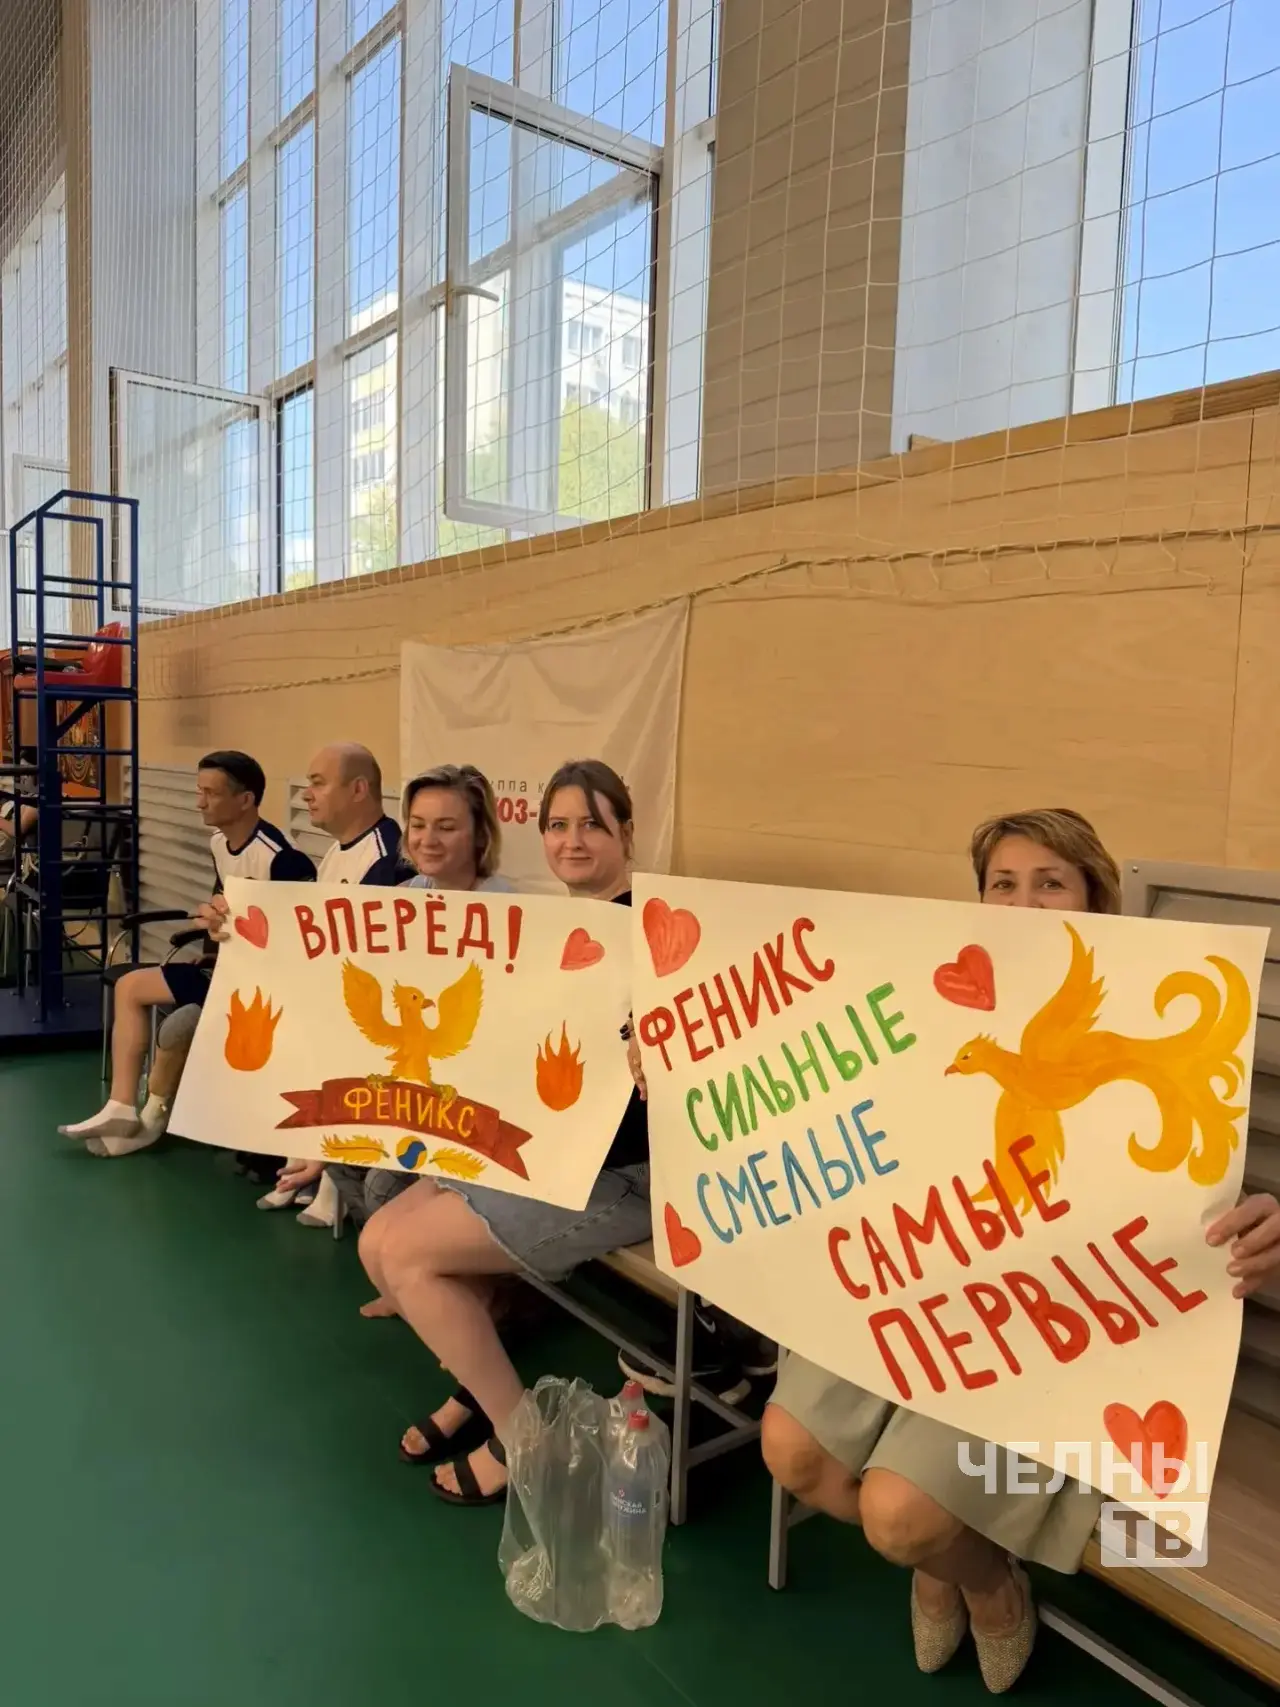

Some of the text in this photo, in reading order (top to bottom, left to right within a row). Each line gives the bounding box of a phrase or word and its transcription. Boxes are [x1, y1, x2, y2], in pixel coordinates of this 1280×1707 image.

[295, 893, 523, 973] ВПЕРЁД!
[638, 917, 835, 1071] ФЕНИКС
[343, 1086, 478, 1138] ФЕНИКС
[686, 981, 917, 1151] СИЛЬНЫЕ
[696, 1098, 900, 1244] СМЕЛЫЕ
[828, 1135, 1070, 1300] САМЫЕ
[868, 1215, 1208, 1401] ПЕРВЫЕ
